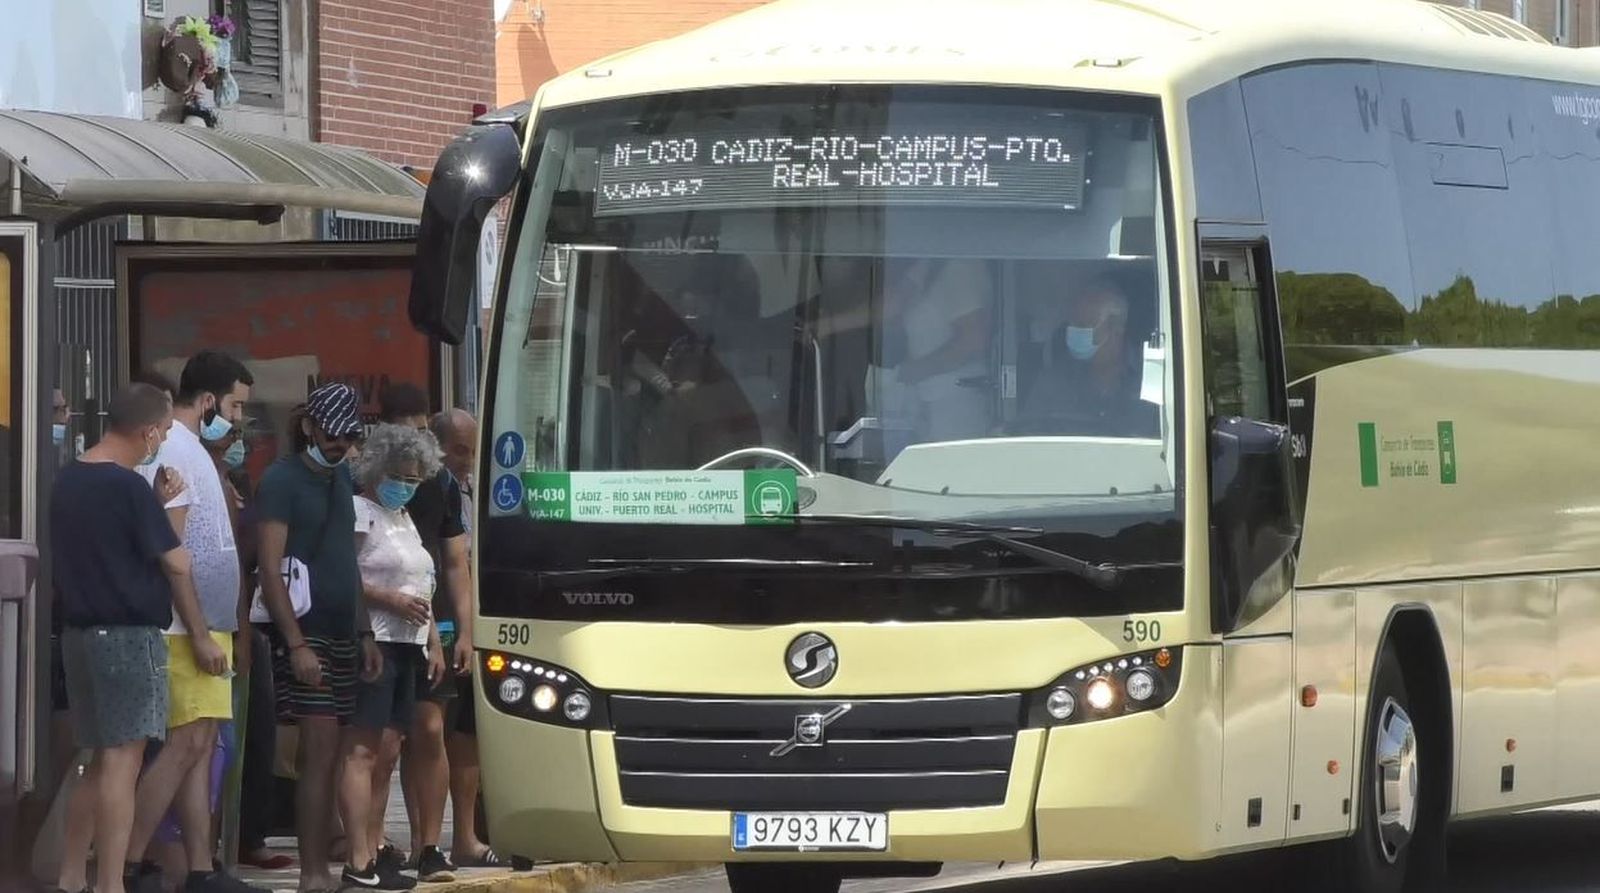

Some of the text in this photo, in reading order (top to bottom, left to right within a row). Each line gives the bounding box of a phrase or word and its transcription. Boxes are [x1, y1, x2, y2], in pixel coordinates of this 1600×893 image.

[1551, 92, 1600, 125] www.tgco
[614, 139, 697, 166] M-030
[528, 488, 566, 502] M-030
[575, 489, 602, 502] CÁDIZ
[612, 489, 629, 502] RÍO
[632, 490, 651, 502] SAN
[654, 490, 688, 501] PEDRO
[698, 489, 739, 501] CAMPUS
[578, 505, 602, 516] UNIV.
[612, 505, 650, 516] PUERTO
[653, 504, 678, 515] REAL
[688, 503, 735, 515] HOSPITAL
[562, 592, 634, 605] VOLVO
[498, 624, 530, 645] 590
[1123, 620, 1161, 642] 590
[754, 817, 877, 842] 9793 KZY
